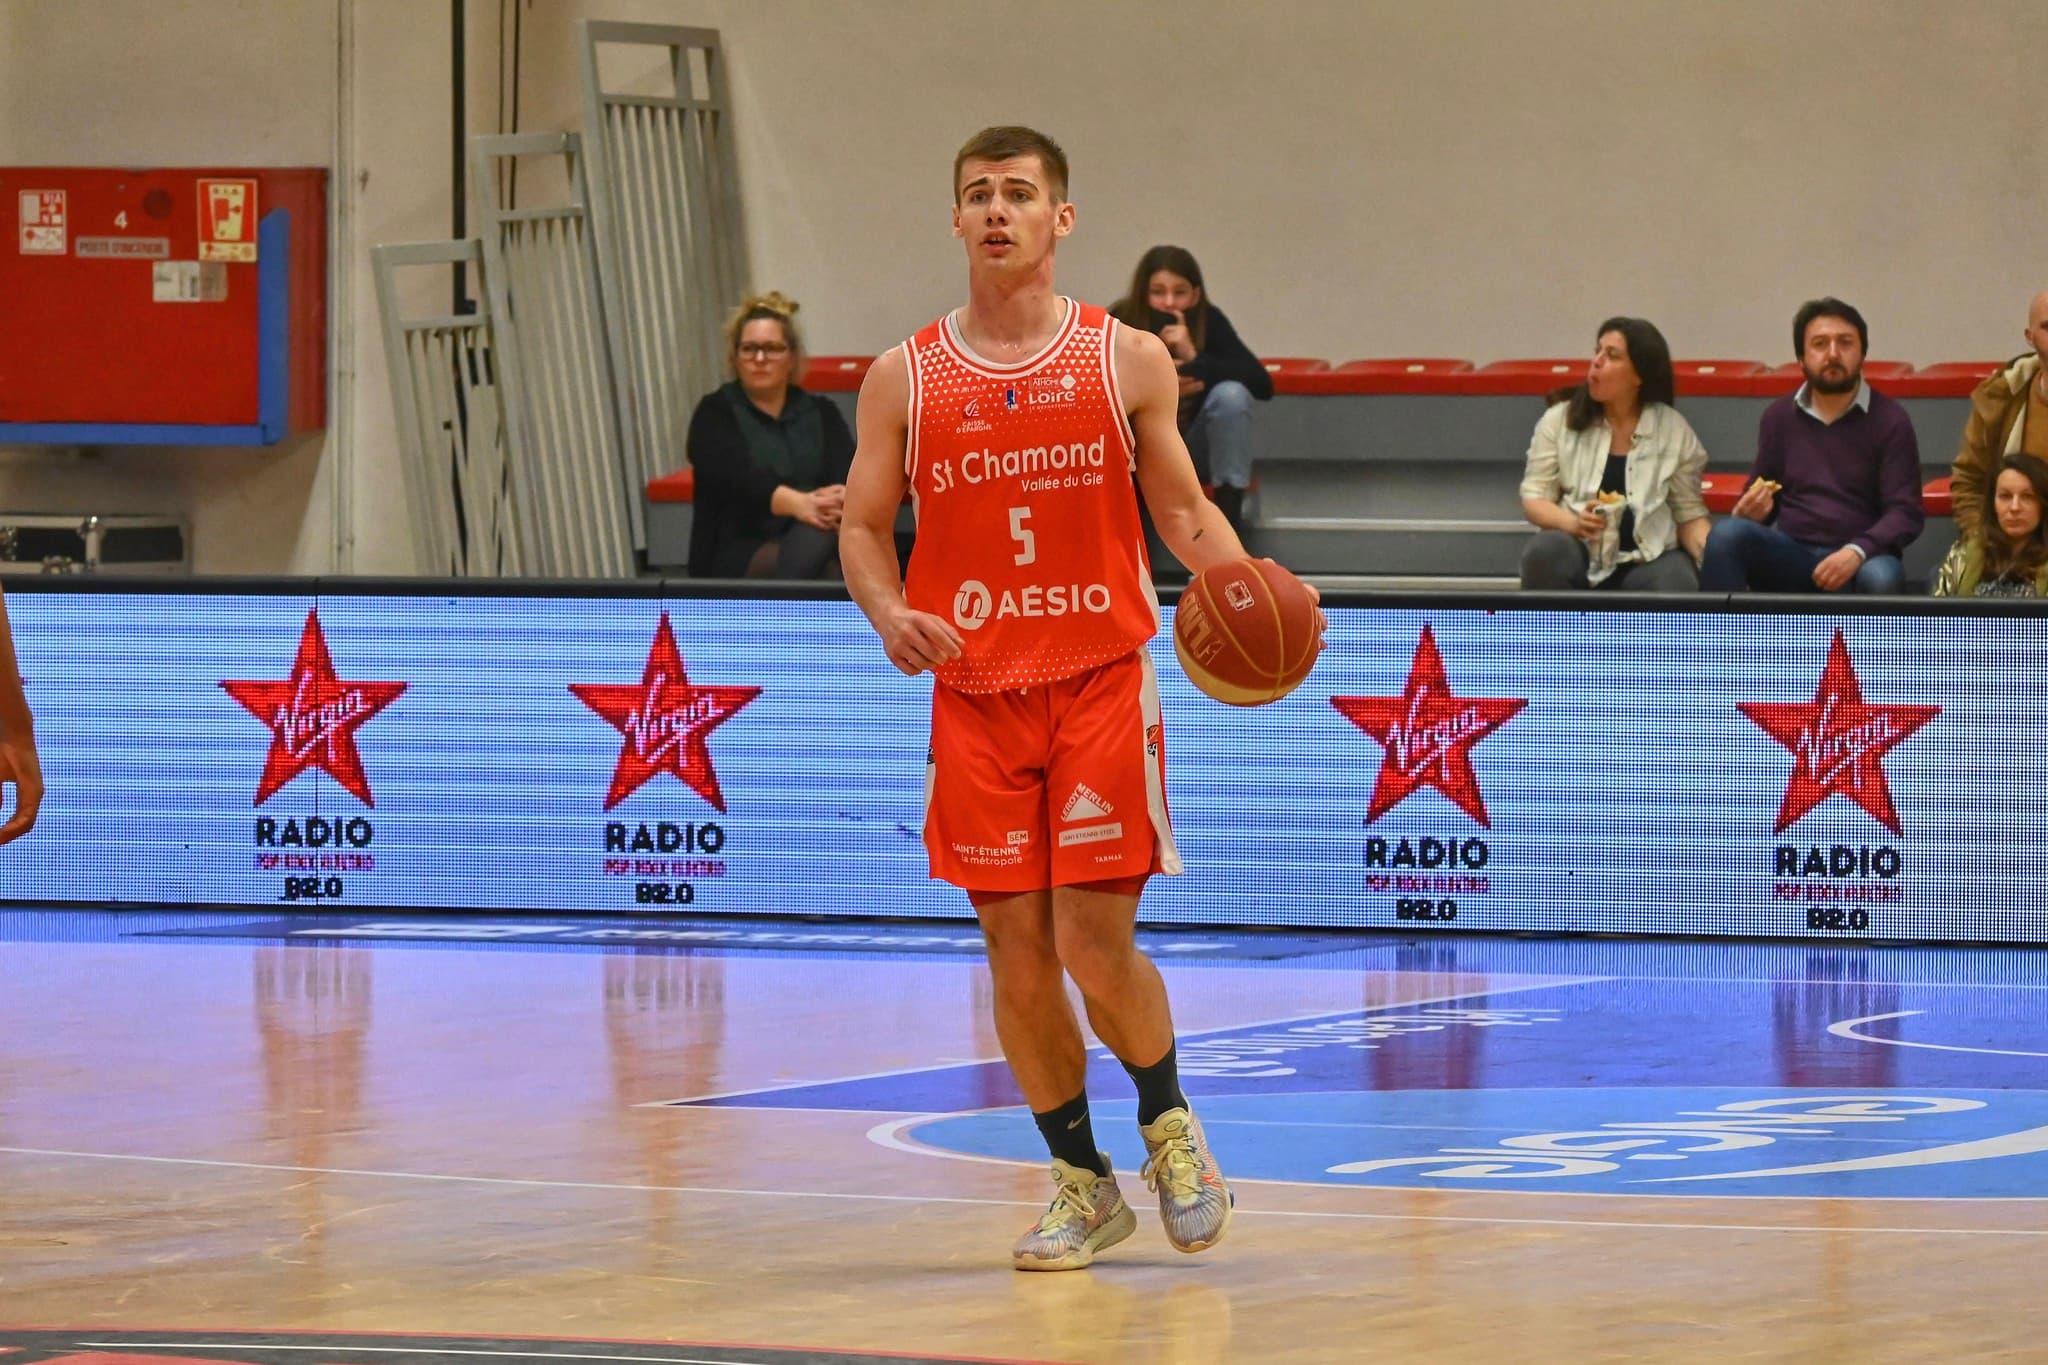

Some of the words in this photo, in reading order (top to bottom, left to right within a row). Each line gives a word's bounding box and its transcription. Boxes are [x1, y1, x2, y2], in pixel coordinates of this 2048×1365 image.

[114, 211, 128, 229] 4
[932, 459, 954, 493] St
[961, 434, 1105, 485] Chamond
[1021, 475, 1060, 492] Vallée
[1063, 474, 1079, 488] du
[1008, 506, 1036, 566] 5
[997, 583, 1111, 620] AÉSIO
[1076, 782, 1114, 814] MERLIN
[256, 817, 373, 847] RADIO
[606, 822, 724, 853] RADIO
[970, 856, 1023, 868] métropole
[1366, 837, 1489, 869] RADIO
[1775, 846, 1901, 877] RADIO
